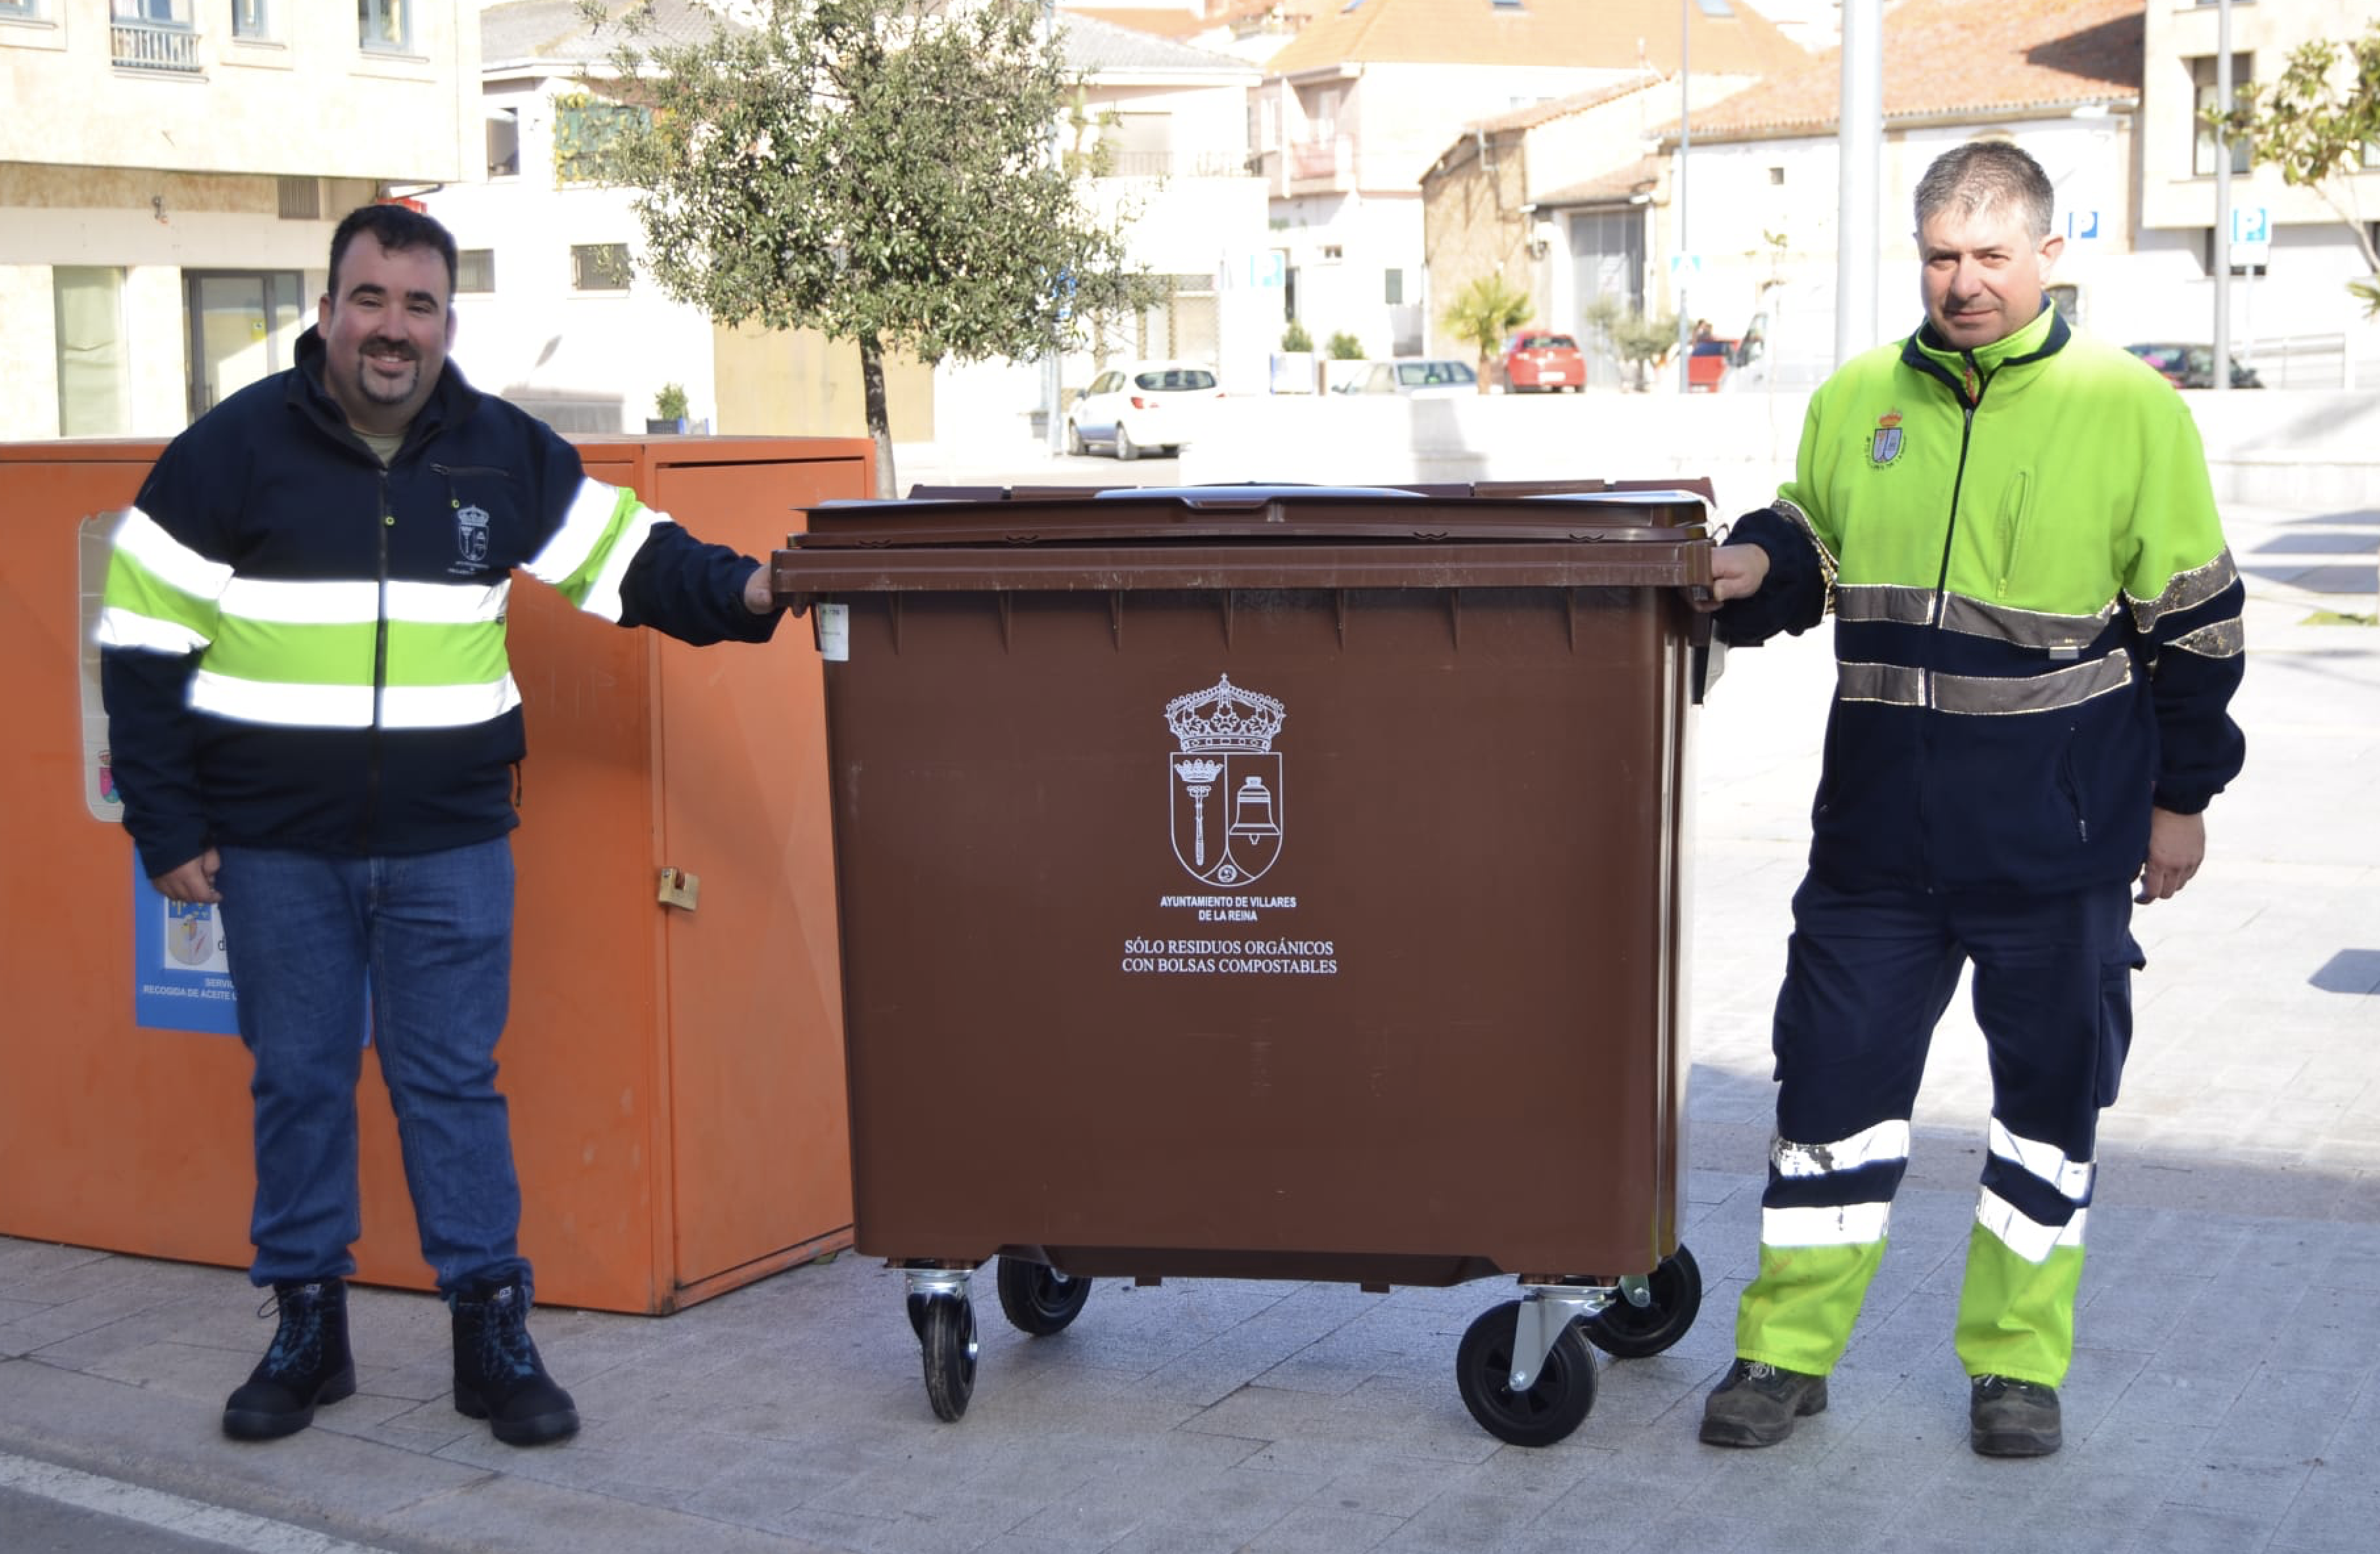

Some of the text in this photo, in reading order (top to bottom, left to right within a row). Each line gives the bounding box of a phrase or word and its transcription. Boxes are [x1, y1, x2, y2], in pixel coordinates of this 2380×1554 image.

[2071, 212, 2093, 239] P
[2237, 209, 2262, 241] P
[1160, 896, 1297, 908] AYUNTAMIENTO DE VILLARES
[1199, 910, 1258, 921] DE LA REINA
[1124, 935, 1334, 955] SÓLO RESIDUOS ORGÁNICOS
[1122, 958, 1338, 974] CON BOLSAS COMPOSTABLES
